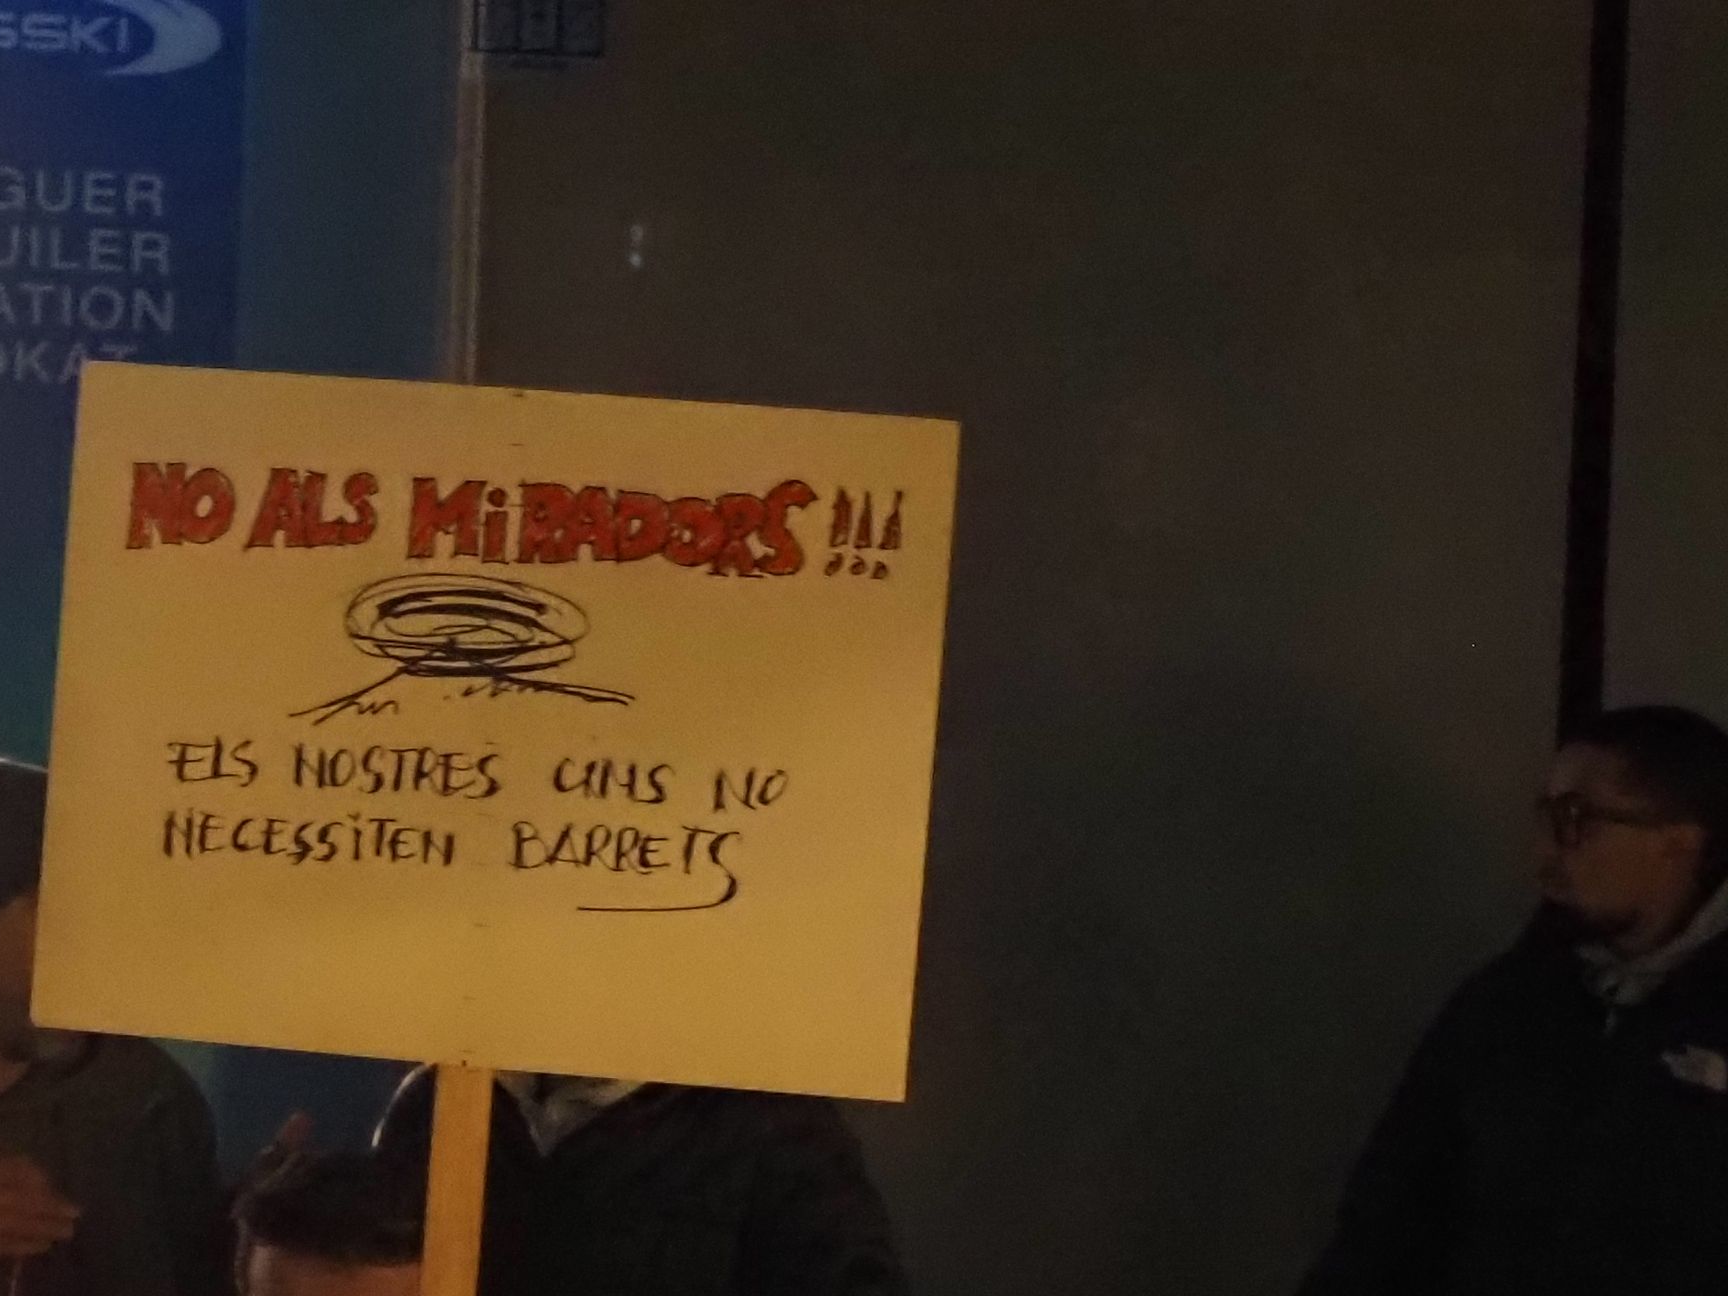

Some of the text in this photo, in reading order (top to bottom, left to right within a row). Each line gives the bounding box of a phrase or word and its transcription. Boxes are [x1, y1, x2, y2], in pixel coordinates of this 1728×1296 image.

[125, 461, 238, 550] NO
[244, 466, 380, 549] ALS
[166, 738, 259, 787] ELS
[292, 743, 504, 800] NOSTRES
[712, 767, 790, 812] NO
[507, 819, 745, 911] BARRETS
